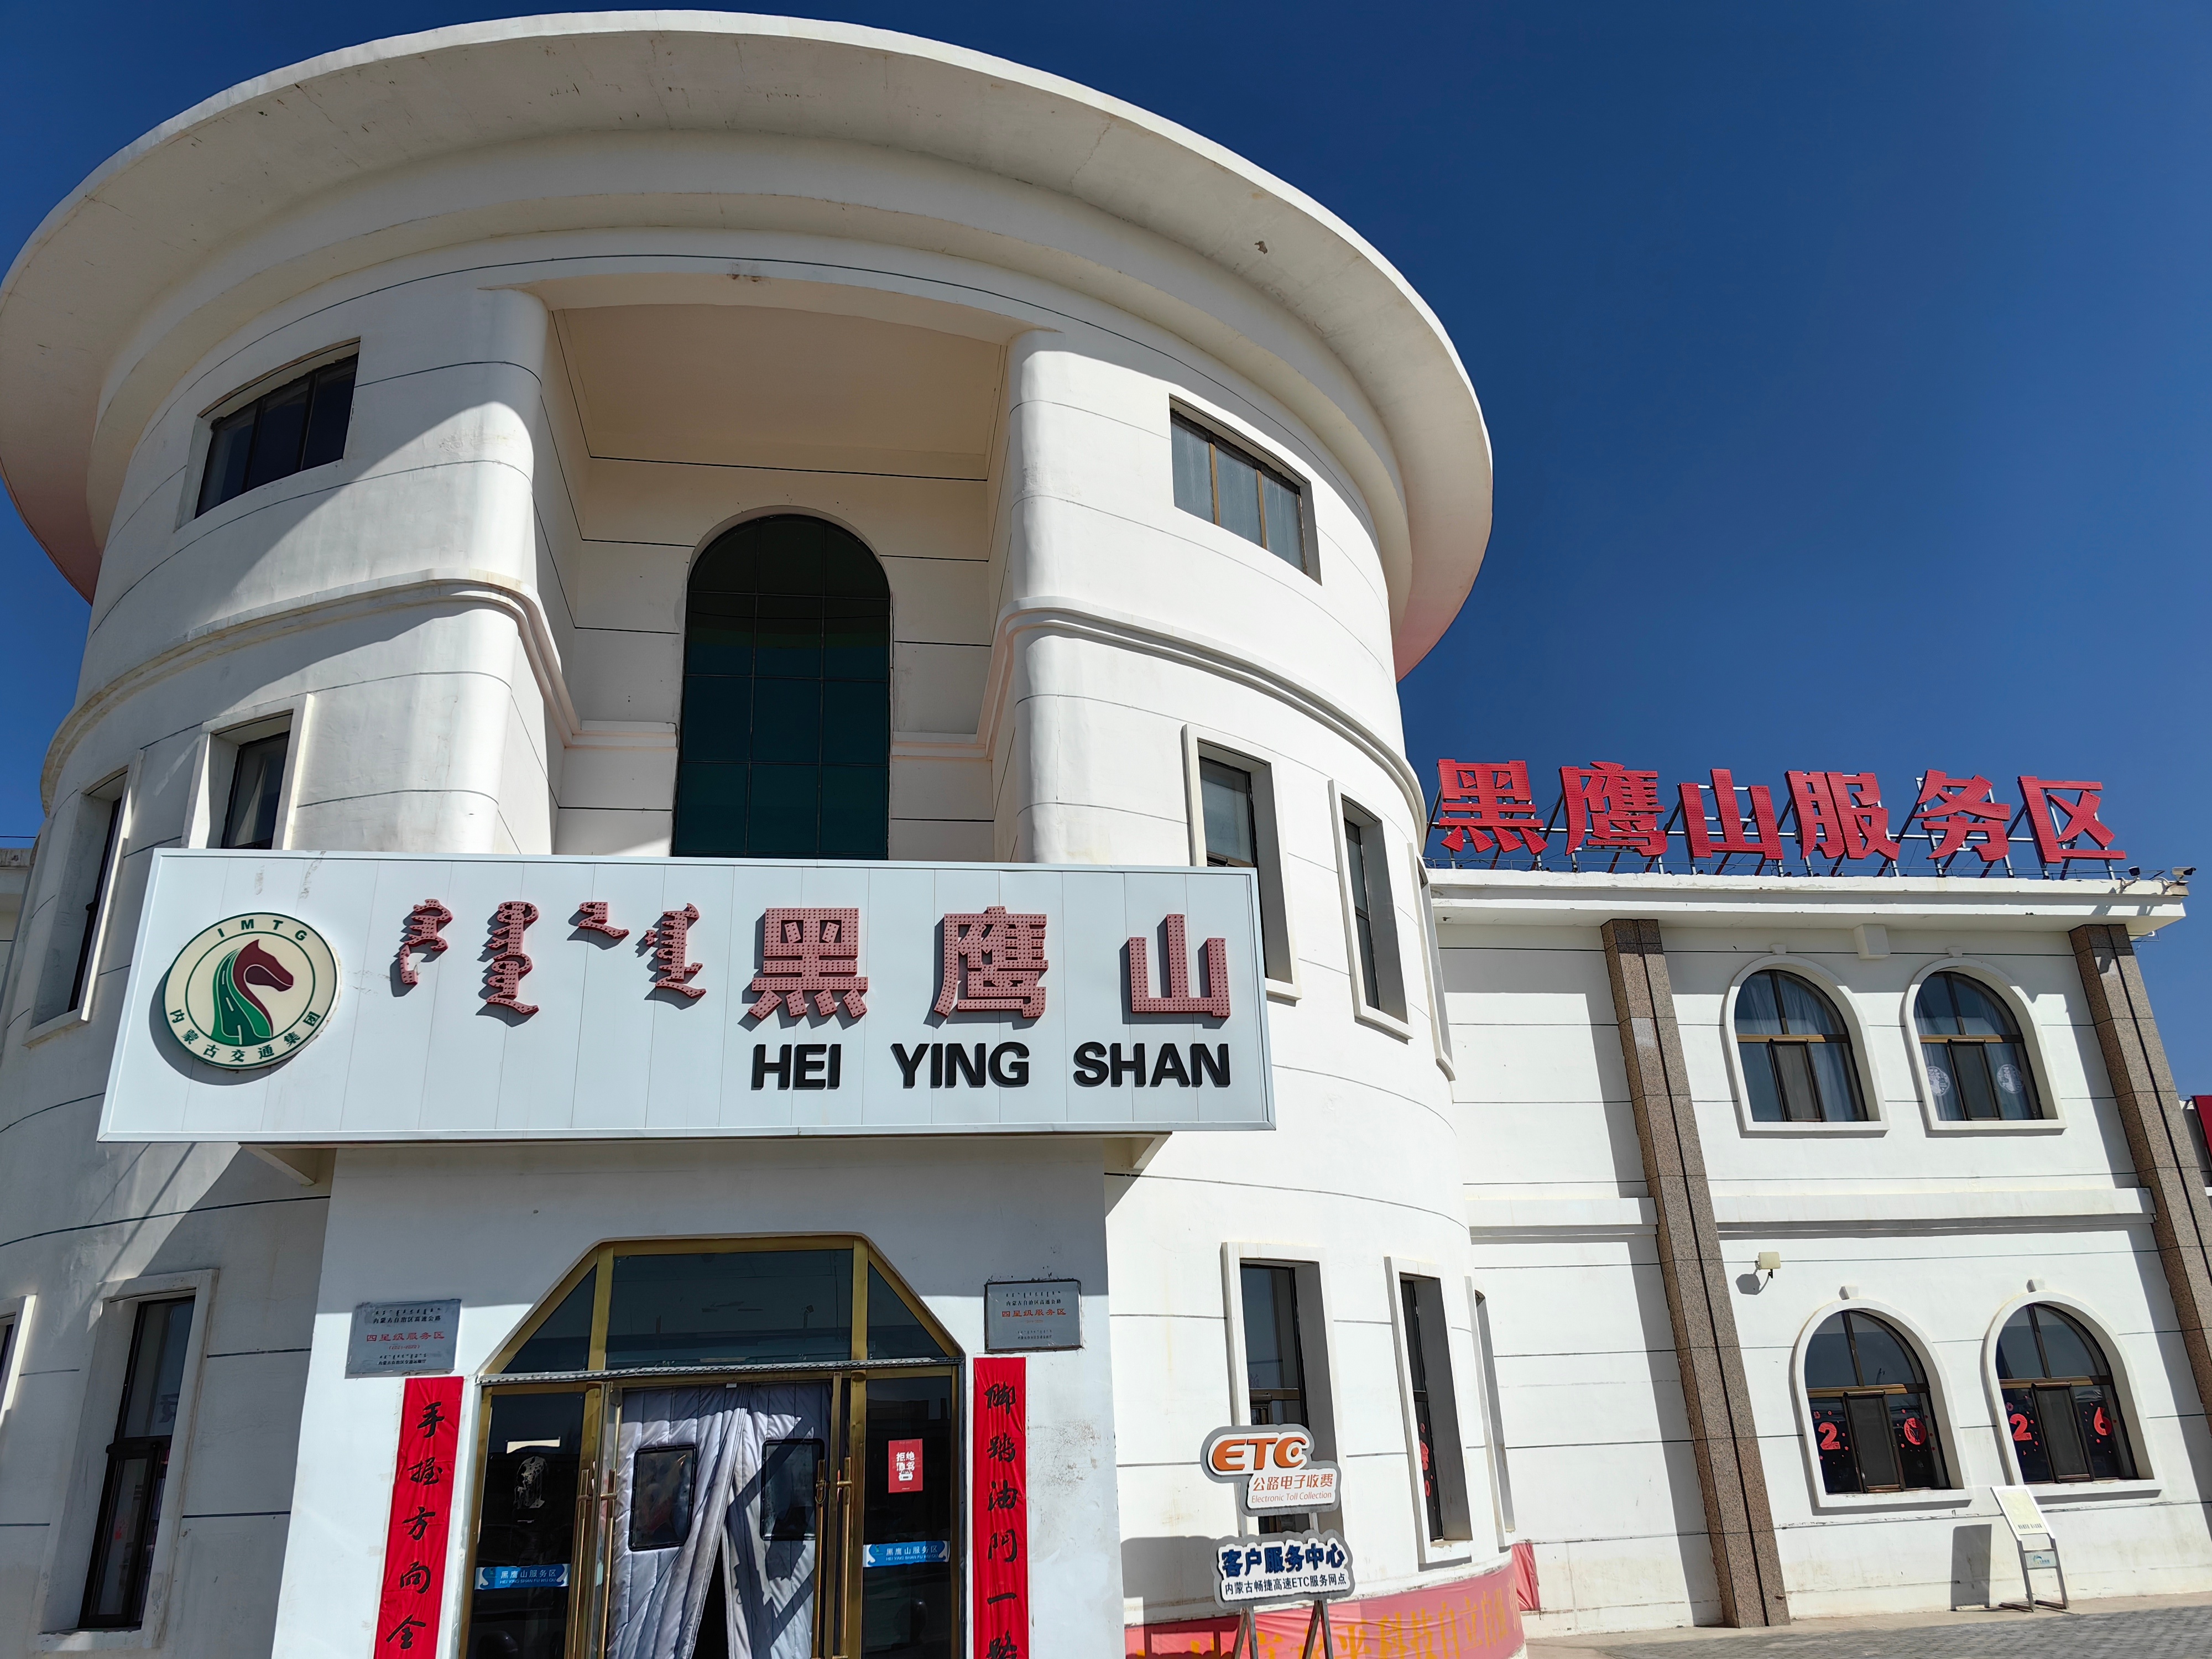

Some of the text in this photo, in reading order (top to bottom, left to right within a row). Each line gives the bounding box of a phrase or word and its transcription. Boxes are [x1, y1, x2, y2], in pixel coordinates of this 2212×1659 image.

[1438, 759, 2126, 863] 黑鹰山服务区
[748, 906, 1233, 1020] 黑鹰山
[169, 1009, 321, 1062] 内蒙古交通集团
[752, 1042, 1230, 1091] HEI YING SHAN
[1002, 1308, 1066, 1317] 四星级服务区
[366, 1331, 445, 1342] 四星级服务区
[1818, 1422, 1840, 1449] 2
[2010, 1413, 2032, 1441] 2
[896, 1451, 915, 1462] 拒绝
[1213, 1437, 1307, 1471] ETC
[1253, 1473, 1334, 1491] 公路电子收费
[1251, 1494, 1285, 1504] Electronic
[1299, 1491, 1332, 1500] Collection
[386, 1401, 446, 1650] 手握方向全
[886, 1545, 938, 1556] 黑鹰山服务区
[1222, 1543, 1345, 1578] 客户服务中心
[500, 1569, 556, 1579] 黑鹰山服务区
[1225, 1573, 1347, 1595] 内蒙古畅捷高速ETC服务网点
